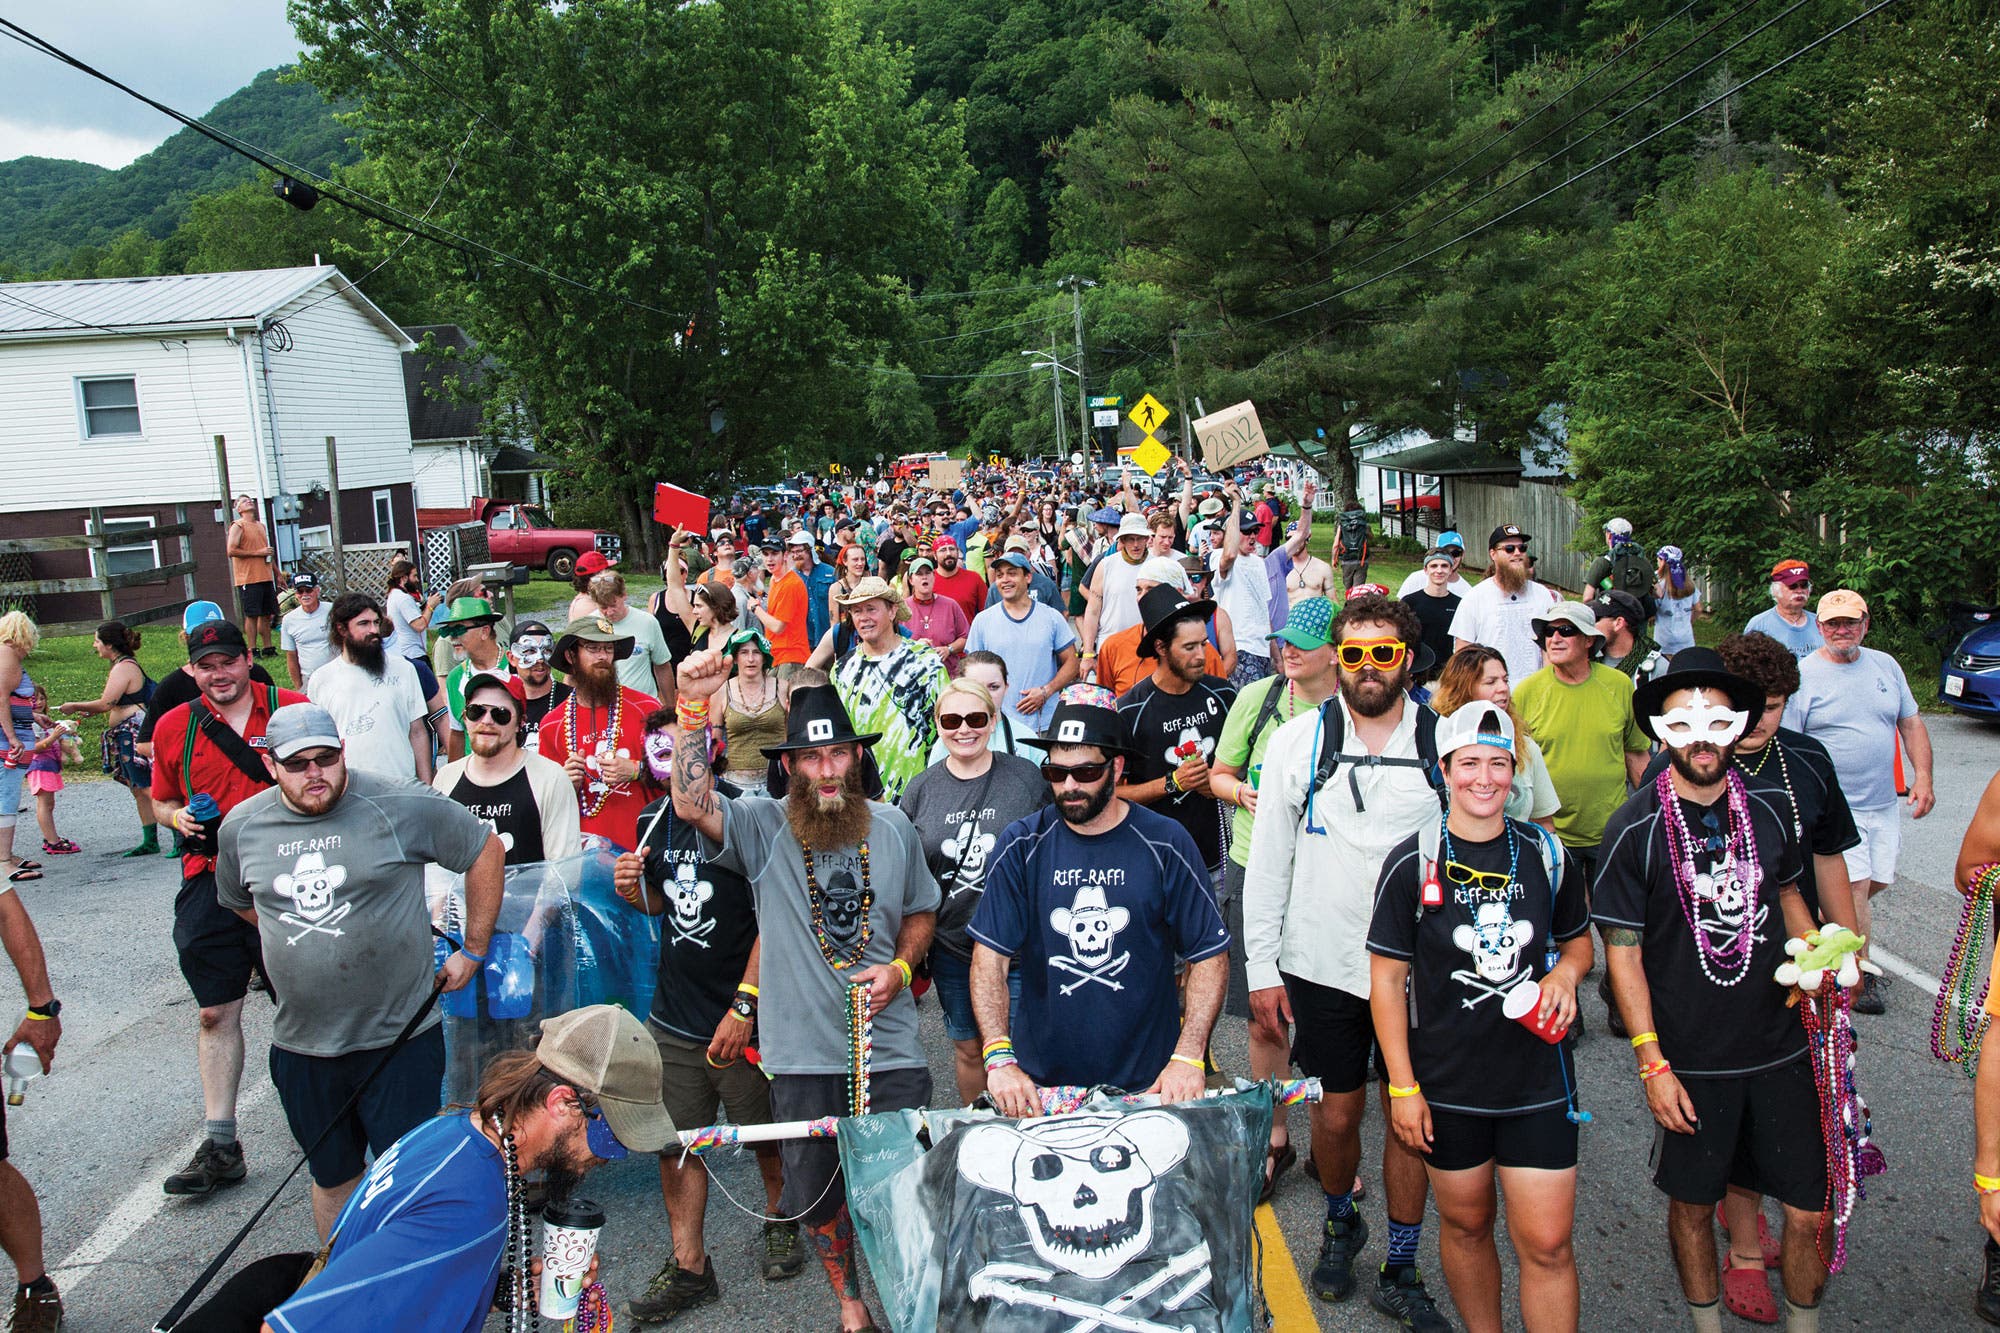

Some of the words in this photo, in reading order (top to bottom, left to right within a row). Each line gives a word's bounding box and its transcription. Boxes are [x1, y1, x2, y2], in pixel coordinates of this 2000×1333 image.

[1090, 396, 1121, 407] SUBWAY
[1206, 416, 1258, 466] 2012
[1206, 696, 1218, 715] C
[1163, 711, 1209, 733] RIFF-RAFF!
[278, 835, 341, 857] RIFF-RAFF!
[1053, 868, 1125, 886] RIFF-RAFF!
